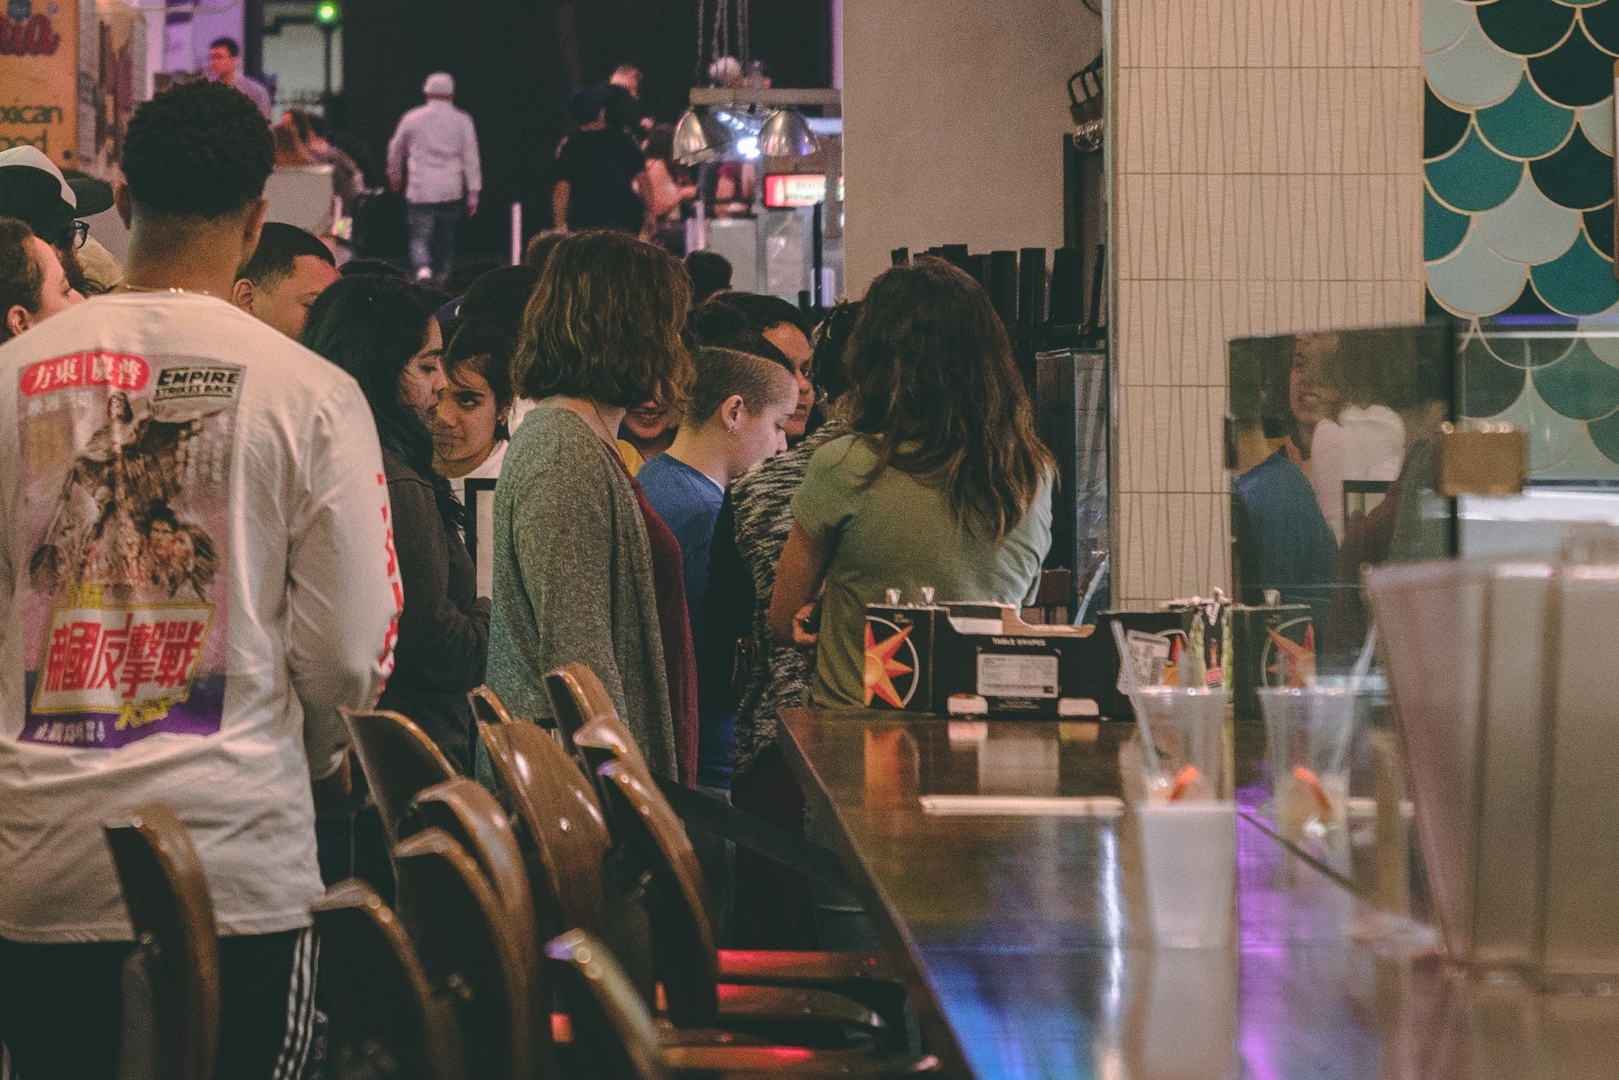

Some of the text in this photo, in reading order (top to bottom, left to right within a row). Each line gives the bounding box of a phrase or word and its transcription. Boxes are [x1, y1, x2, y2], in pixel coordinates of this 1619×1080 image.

[157, 368, 241, 387] EMPIRE
[154, 383, 235, 397] STRIKES BACK
